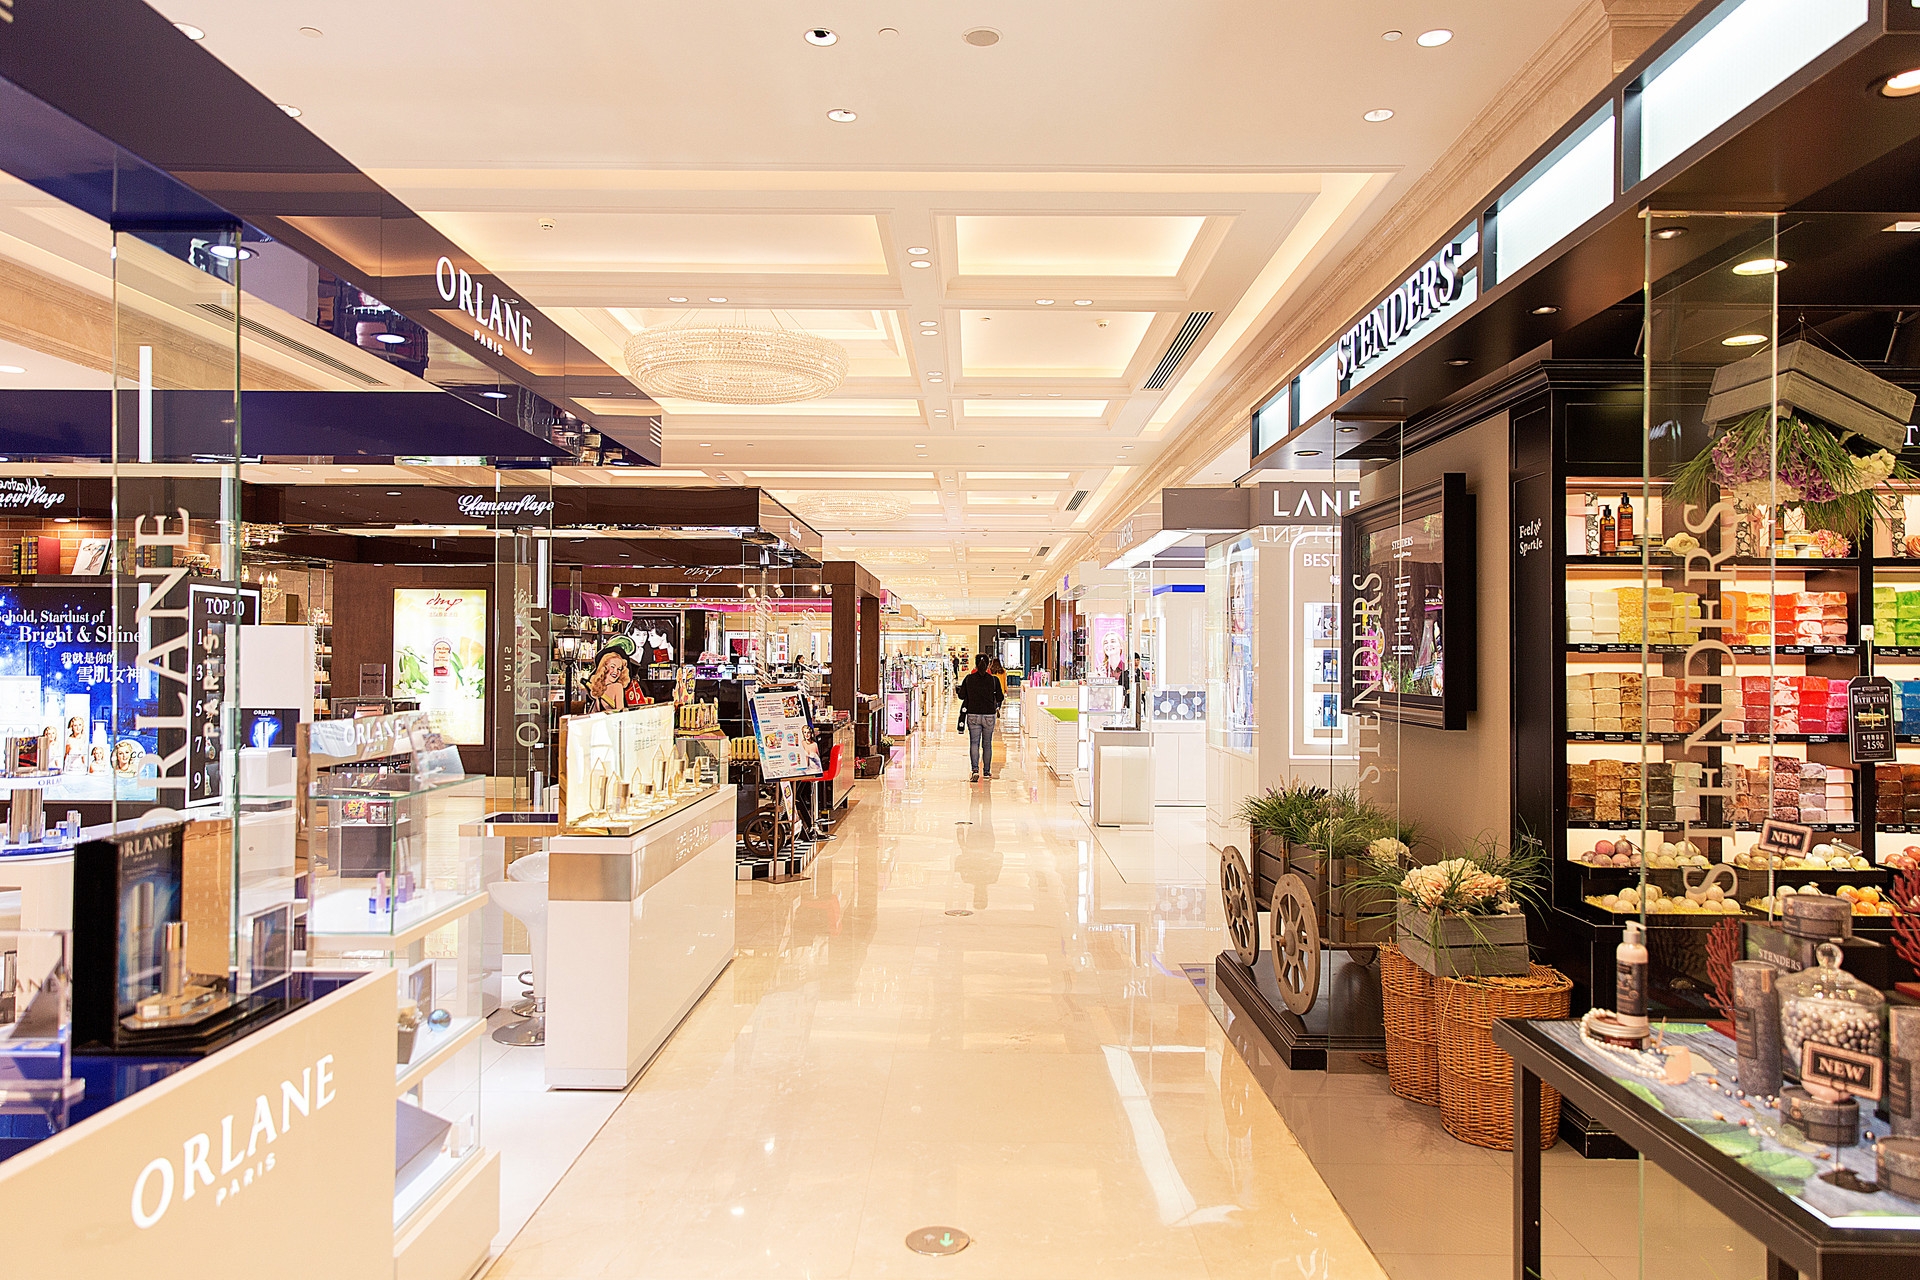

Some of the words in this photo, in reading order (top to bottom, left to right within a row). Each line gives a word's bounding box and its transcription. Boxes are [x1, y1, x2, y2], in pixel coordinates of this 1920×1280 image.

[436, 256, 533, 355] ORLANE
[1338, 243, 1456, 380] STENDERS
[473, 329, 504, 356] PARIS
[457, 494, 554, 516] Glamourflage
[1303, 554, 1340, 568] BEST
[40, 610, 91, 623] Stardust
[93, 610, 106, 623] of
[205, 598, 230, 615] TOP
[232, 600, 245, 616] 10
[19, 625, 73, 648] Bright
[77, 626, 92, 643] &
[61, 652, 117, 664] 我就是你的
[77, 666, 141, 683] 雪肌女神
[196, 664, 203, 681] 3
[1352, 572, 1382, 784] STENDERS
[195, 700, 202, 717] 5
[1684, 503, 1737, 896] STENDERS
[1854, 695, 1870, 704] BATH
[1872, 694, 1889, 703] TIME
[344, 717, 405, 747] ORLANE
[194, 736, 202, 752] 7
[1863, 740, 1885, 750] -15%
[194, 772, 202, 789] 9
[1771, 830, 1800, 846] NEW
[1758, 948, 1801, 971] STENDERS
[1818, 1057, 1864, 1082] NEW
[131, 1054, 336, 1229] ORLANE
[216, 1152, 276, 1207] PARIS
